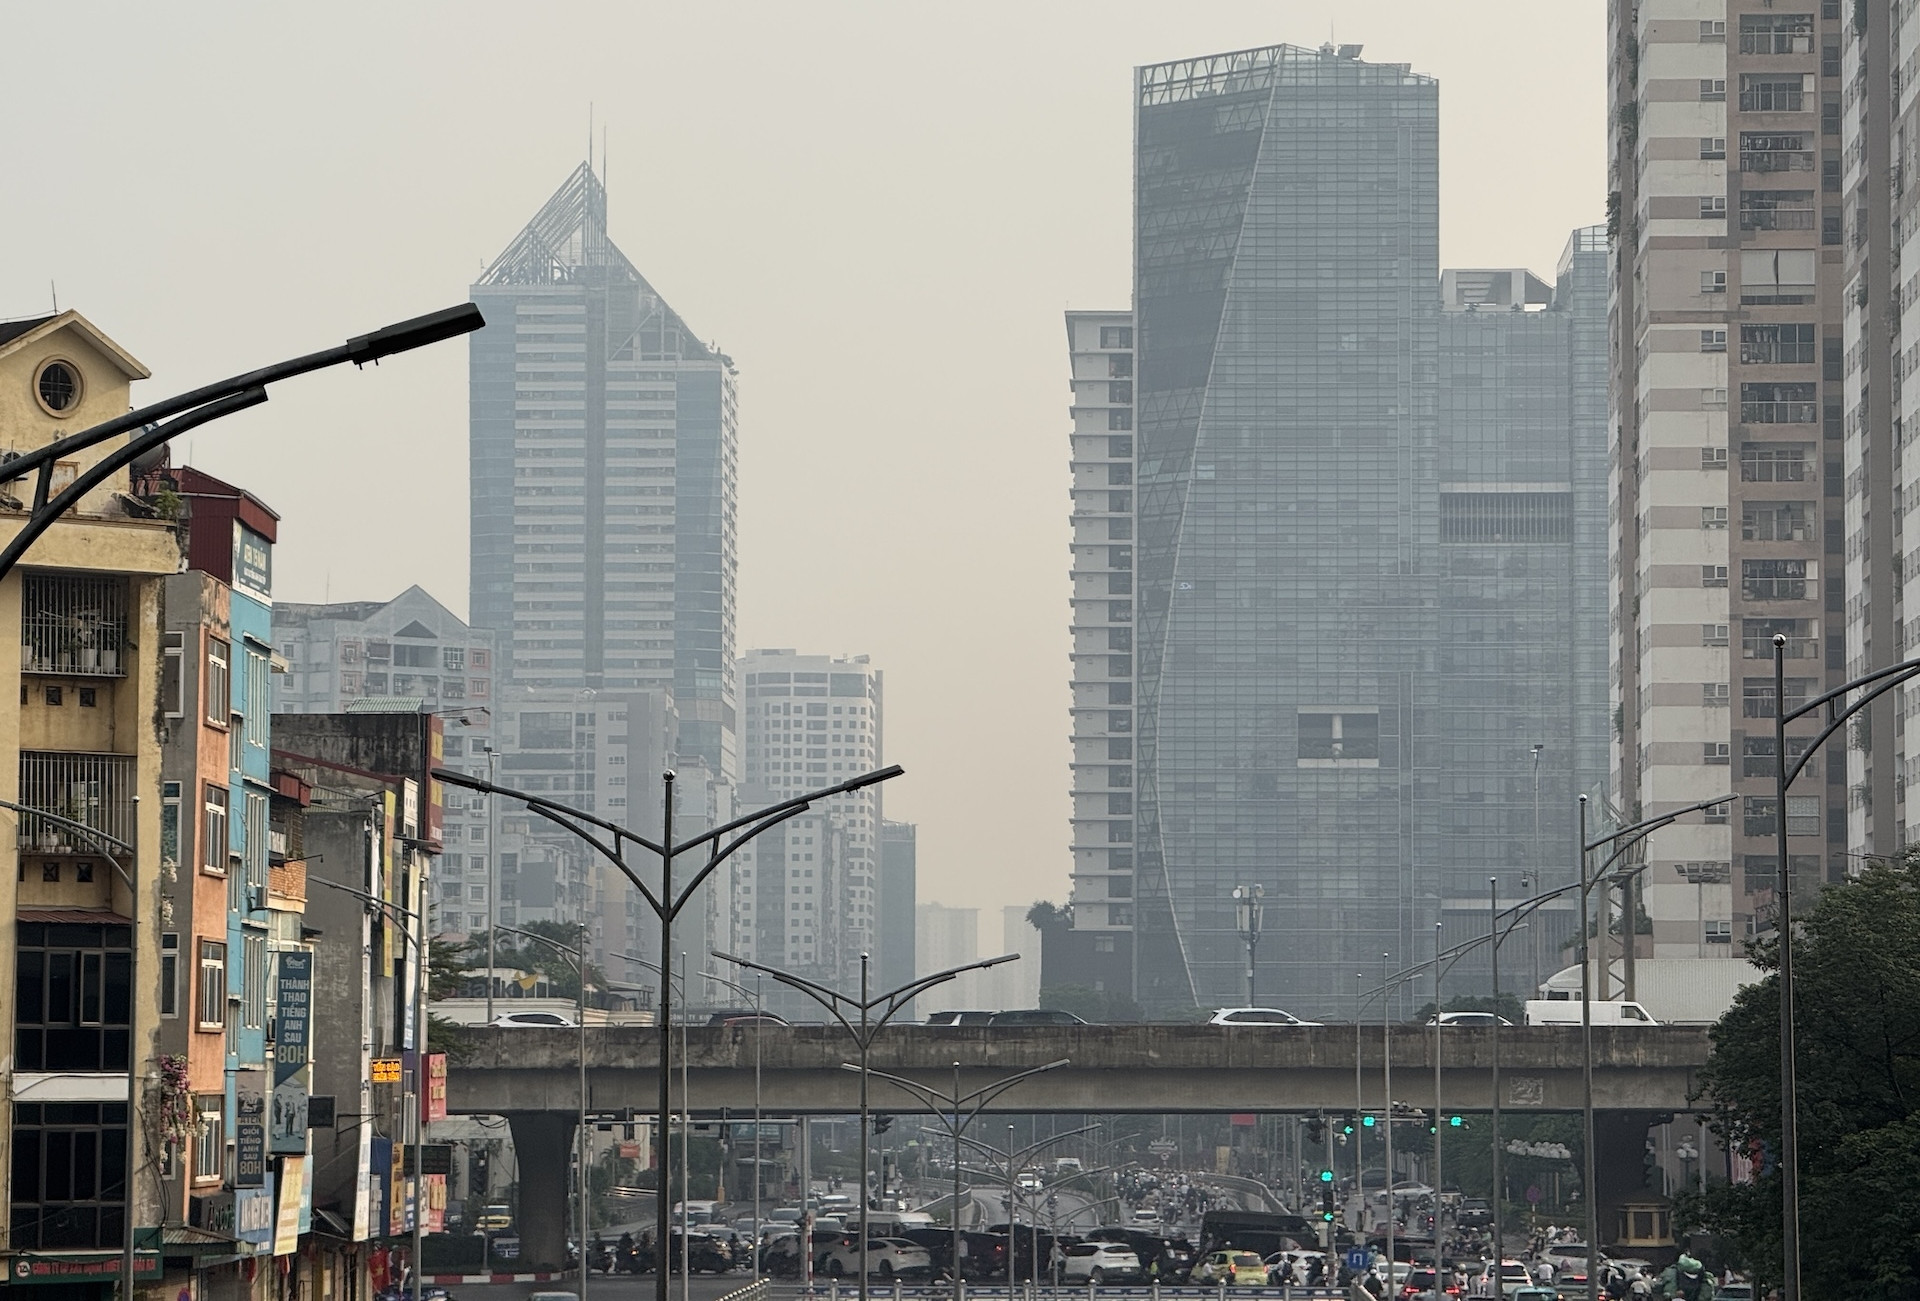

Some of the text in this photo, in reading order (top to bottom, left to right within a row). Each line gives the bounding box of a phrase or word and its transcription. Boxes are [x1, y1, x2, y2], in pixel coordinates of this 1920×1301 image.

[280, 977, 309, 990] THÀNH
[281, 1003, 307, 1018] TIẾNG
[284, 1020, 303, 1031] ANH
[284, 1032, 302, 1043] SAU
[278, 1045, 307, 1064] 80H
[242, 1145, 259, 1153] ANH
[240, 1161, 262, 1175] 80H
